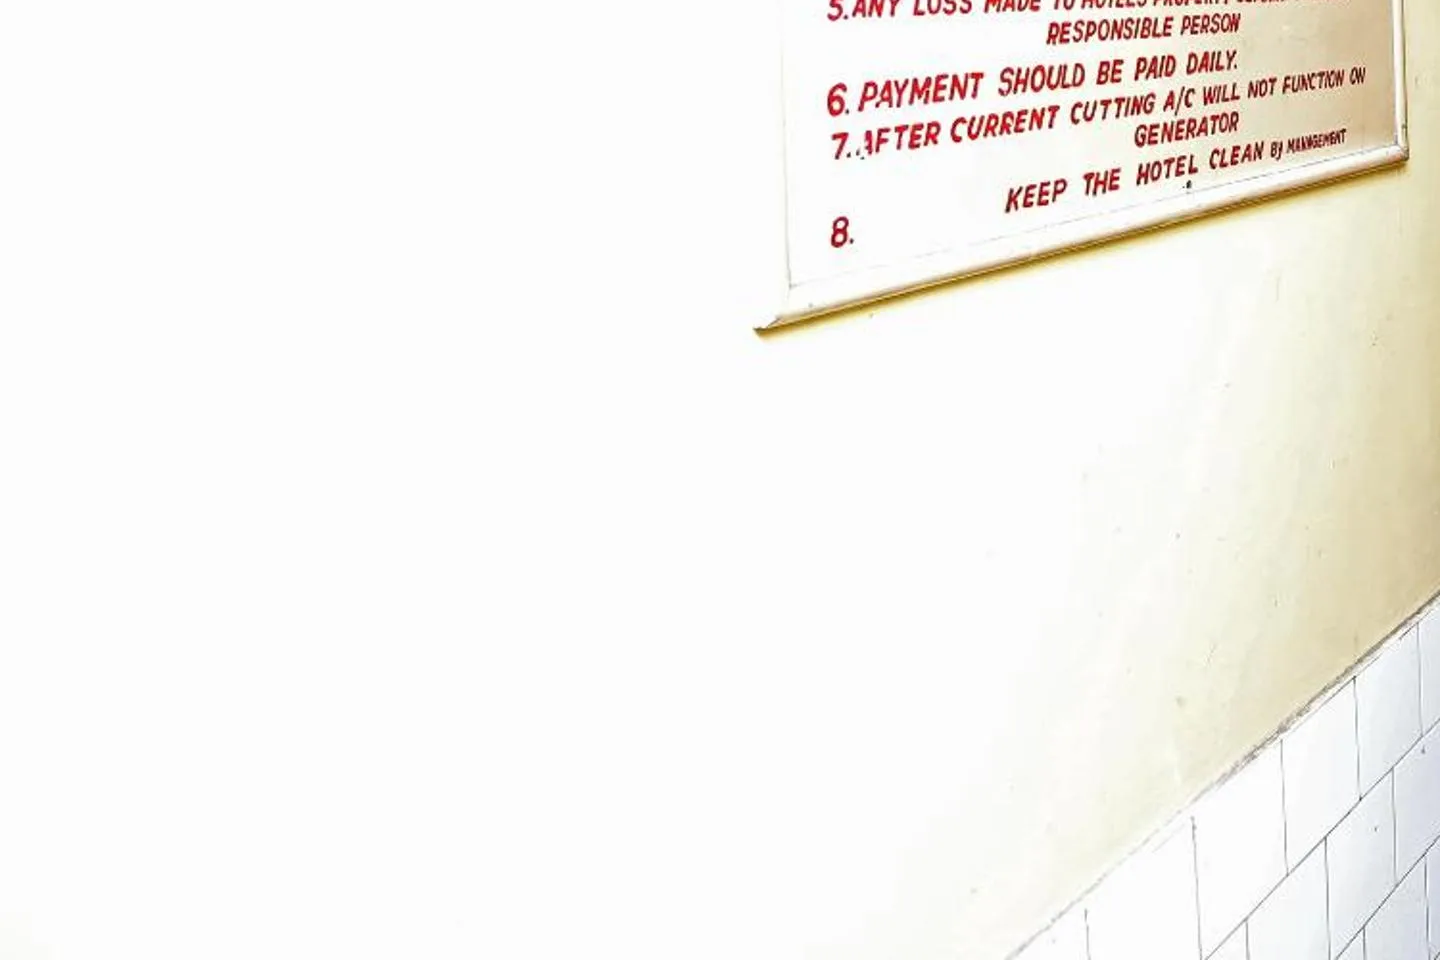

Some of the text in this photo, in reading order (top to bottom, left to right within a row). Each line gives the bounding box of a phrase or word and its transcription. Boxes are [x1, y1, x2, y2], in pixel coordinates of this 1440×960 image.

[1046, 12, 1242, 45] RESPONSIBLE PERSON
[857, 71, 985, 113] PAYMENT
[997, 62, 1086, 97] SHOULD
[1095, 58, 1124, 86] BE
[1133, 53, 1177, 82] PAID
[1185, 50, 1238, 76] DAILY.
[857, 120, 942, 157] AFTER
[949, 105, 1061, 144] CURRENT
[1069, 90, 1157, 125] CUTTING
[1161, 85, 1198, 117] A/C
[1201, 82, 1242, 106] WILL
[1246, 75, 1278, 99] NOT
[1281, 69, 1347, 95] FUNCTION
[1348, 66, 1366, 86] ON
[1133, 110, 1241, 149] GENERATOR
[1004, 178, 1068, 213] KEEP
[1082, 167, 1122, 196] THE
[1134, 153, 1200, 187] HOTEL
[1208, 140, 1266, 170] CLEAN
[1286, 128, 1347, 155] MANAGEMENT
